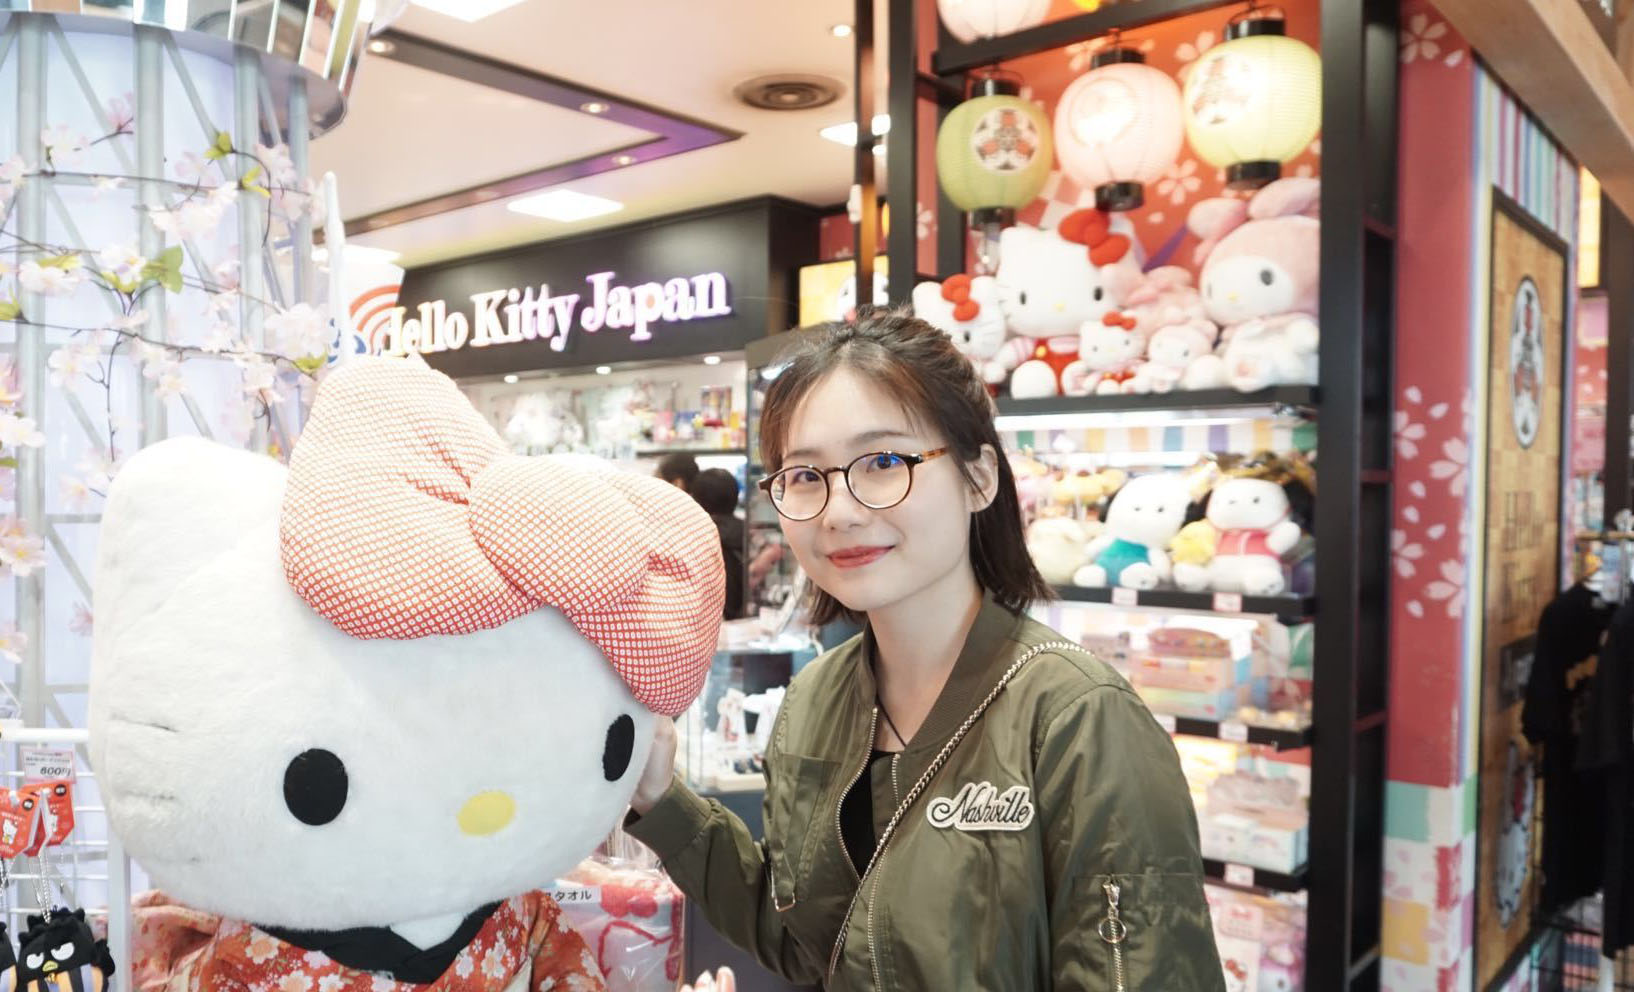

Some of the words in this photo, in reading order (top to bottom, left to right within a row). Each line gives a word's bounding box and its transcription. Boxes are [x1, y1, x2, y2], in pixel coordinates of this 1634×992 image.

[470, 284, 580, 351] Kitty
[581, 271, 731, 341] Japan
[932, 786, 1030, 824] Nashville
[546, 890, 592, 901] タオル
